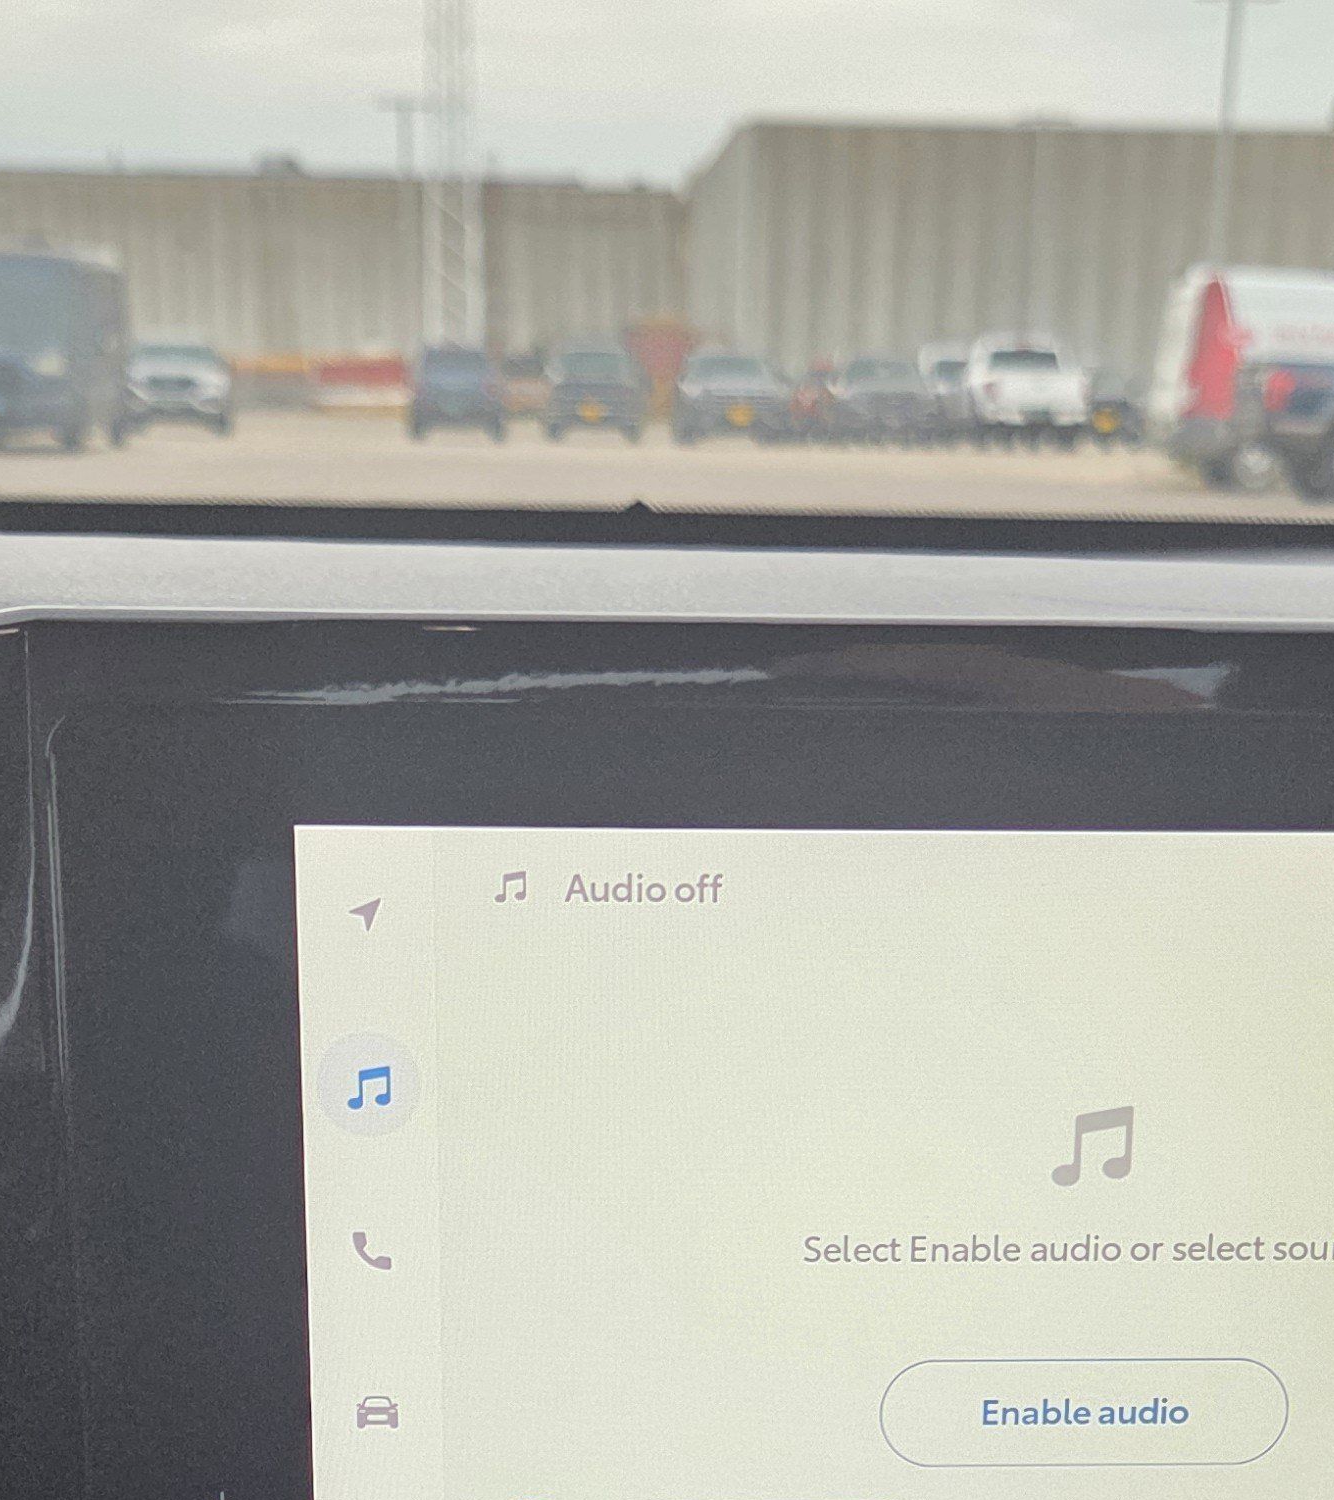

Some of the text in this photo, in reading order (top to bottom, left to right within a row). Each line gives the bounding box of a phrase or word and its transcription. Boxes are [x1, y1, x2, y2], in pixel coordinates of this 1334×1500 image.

[564, 872, 724, 904] Audio off
[803, 1234, 902, 1263] Select
[910, 1234, 1021, 1263] Enable
[1030, 1233, 1122, 1262] audio
[1130, 1242, 1164, 1262] or
[1172, 1232, 1266, 1262] select
[982, 1397, 1189, 1426] Enable audio
